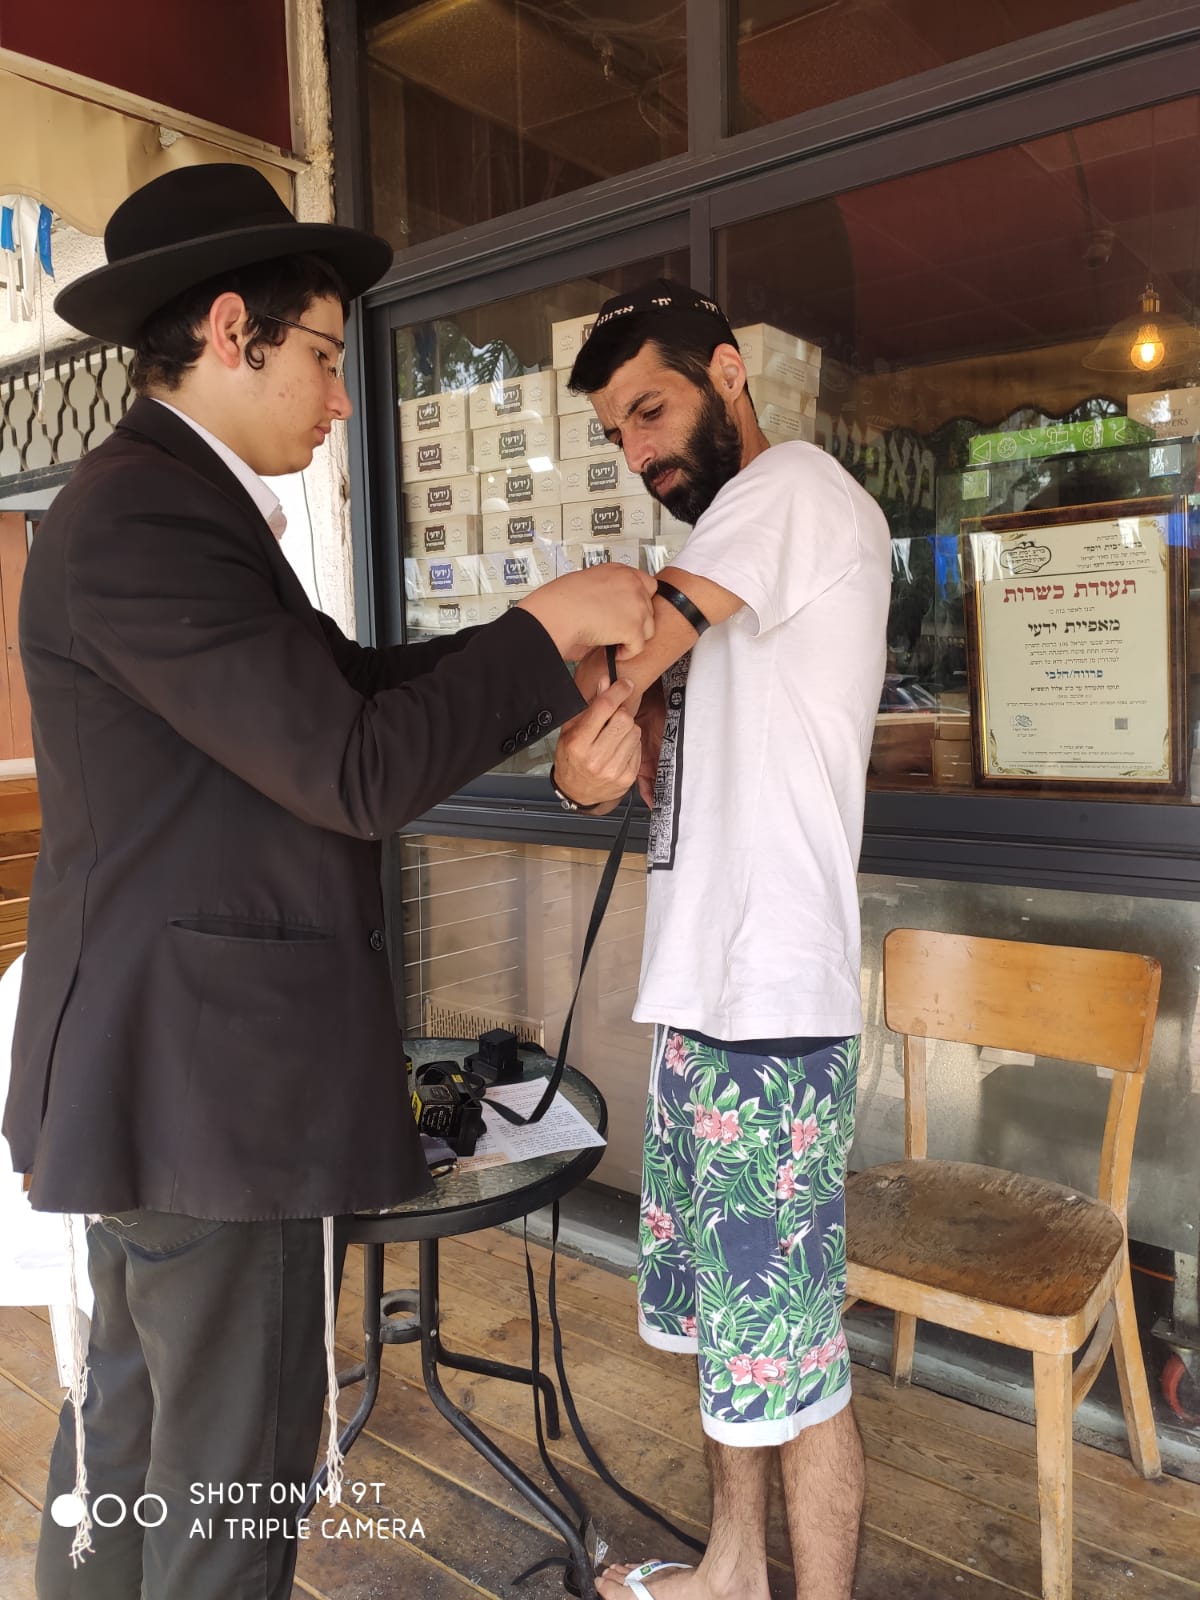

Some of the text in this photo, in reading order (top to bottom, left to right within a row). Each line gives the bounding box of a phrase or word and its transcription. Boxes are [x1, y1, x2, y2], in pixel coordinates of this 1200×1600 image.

[1003, 579, 1136, 603] תעודת כשרות
[1027, 619, 1120, 637] מאפיית ידעי
[1044, 668, 1104, 680] פרווה/חלבי
